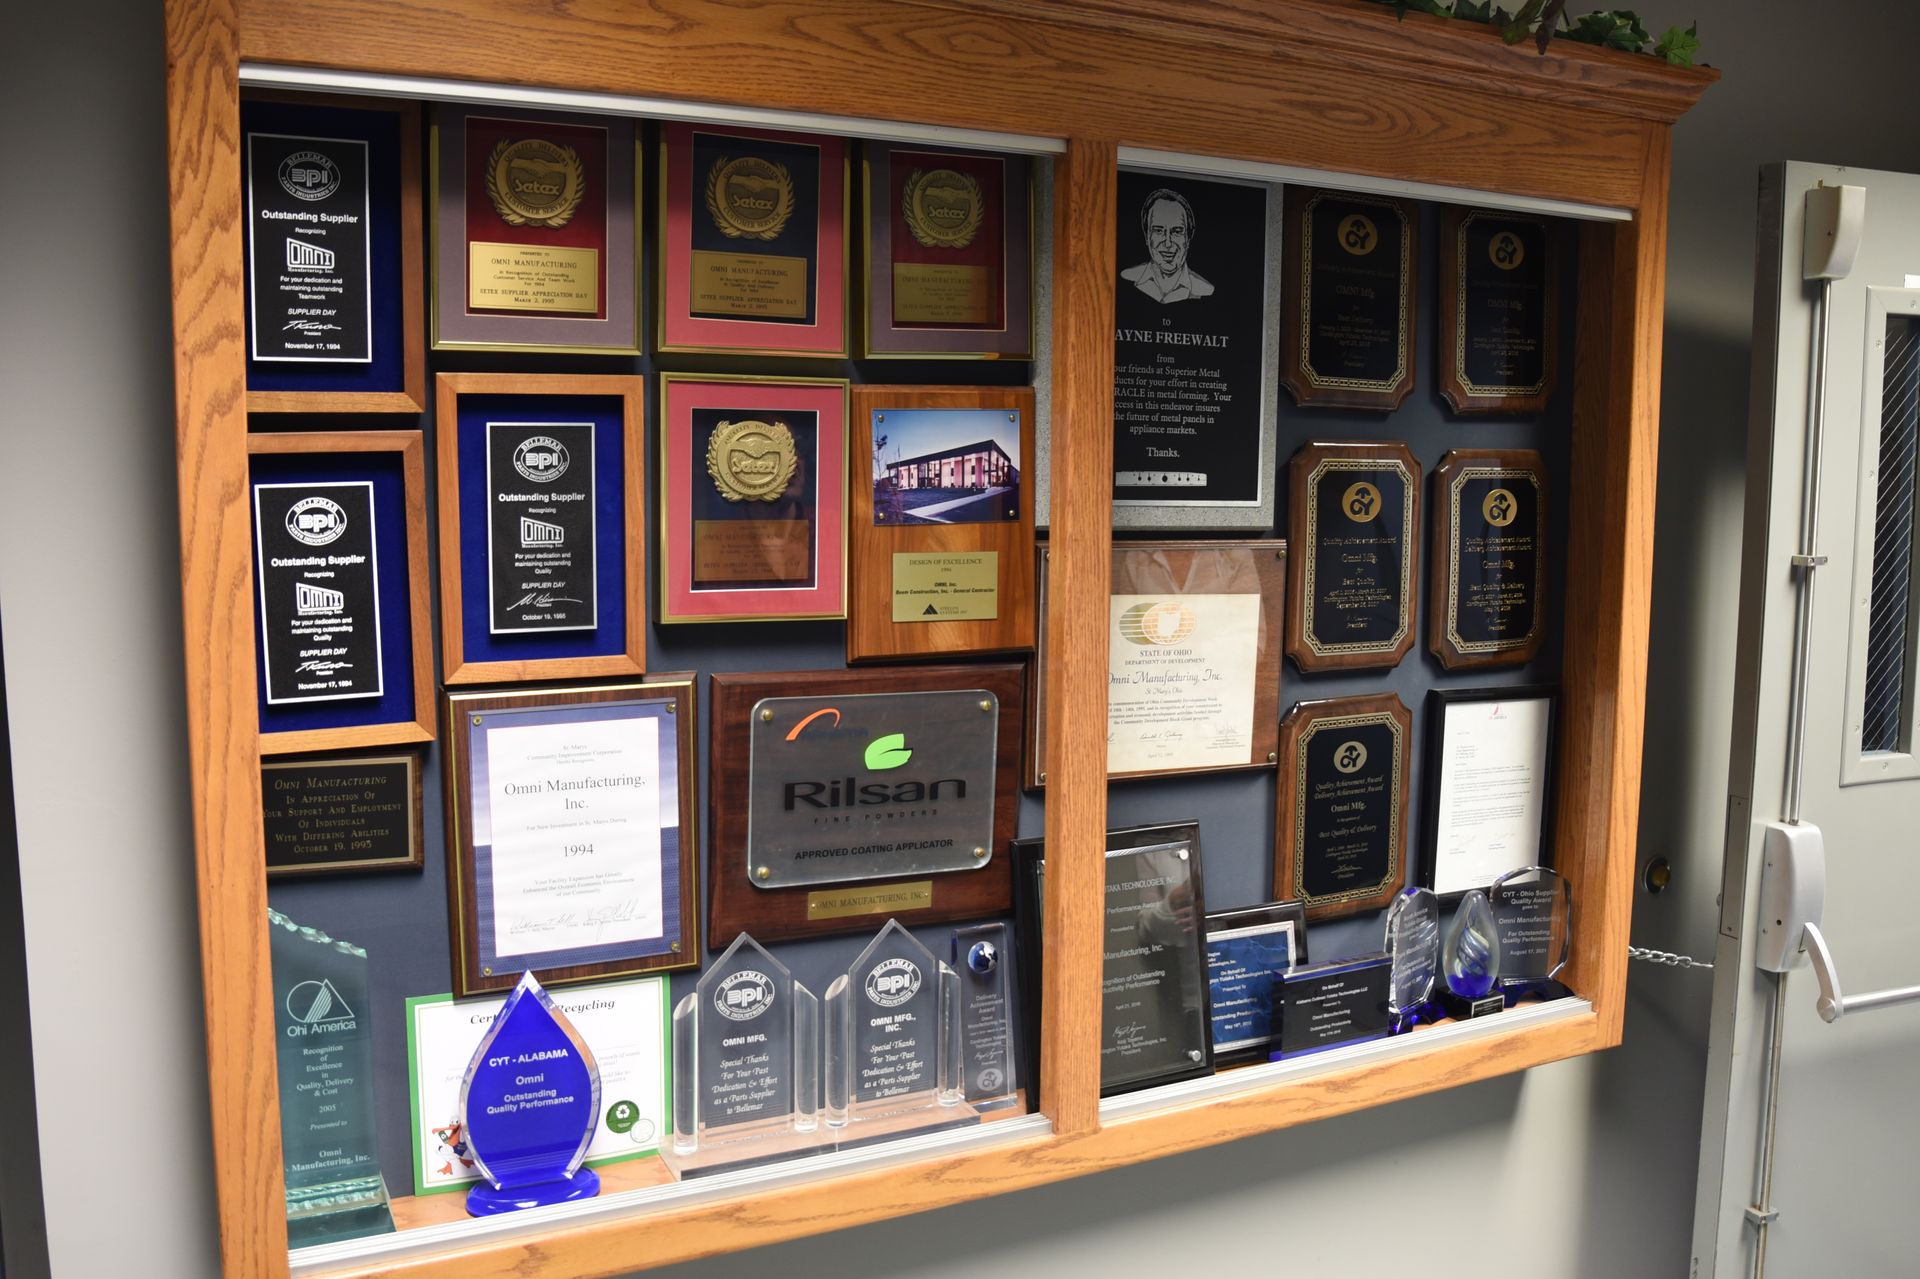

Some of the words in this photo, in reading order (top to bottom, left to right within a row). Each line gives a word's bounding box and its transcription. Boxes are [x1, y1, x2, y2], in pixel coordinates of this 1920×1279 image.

[292, 168, 328, 187] BPI
[262, 210, 318, 223] Outstanding
[320, 213, 359, 224] Supplier
[492, 258, 510, 266] OMNI
[515, 259, 577, 269] MANUFACTURING
[288, 308, 321, 316] SUPPLIER
[1162, 318, 1172, 326] to
[1114, 328, 1153, 343] AYNE
[1155, 331, 1229, 348] FREEWALT
[285, 342, 315, 350] November
[1156, 354, 1175, 364] from
[1128, 364, 1155, 375] friends
[1165, 366, 1198, 378] Superior
[1199, 368, 1221, 378] Metal
[1136, 375, 1147, 385] for
[1148, 378, 1167, 388] your
[1167, 377, 1190, 387] effort
[1198, 379, 1229, 392] creating
[1113, 387, 1147, 398] RACLE
[1157, 389, 1177, 399] metal
[1213, 392, 1233, 402] Your
[1145, 400, 1160, 410] this
[1160, 401, 1195, 412] endeavor
[1195, 402, 1222, 413] insures
[1126, 411, 1151, 422] future
[1161, 412, 1182, 423] metal
[1182, 414, 1206, 426] panels
[1129, 425, 1166, 436] appliance
[525, 453, 559, 469] BPI
[499, 492, 550, 503] Outstanding
[551, 493, 586, 503] Supplier
[299, 514, 335, 532] BPI
[271, 556, 326, 567] Outstanding
[327, 555, 366, 566] Supplier
[521, 582, 553, 590] SUPPLIER
[300, 649, 333, 657] SUPPLIER
[1139, 649, 1160, 657] STATE
[1162, 649, 1173, 657] OF
[1173, 648, 1193, 657] OHIO
[1168, 657, 1205, 665] DEVELOPMENT
[274, 778, 301, 791] OMNI
[306, 776, 388, 790] MANUFACTURING
[504, 779, 543, 798] Omni
[302, 793, 361, 804] APPRECIATION
[784, 777, 967, 812] Rilsan
[287, 807, 324, 817] SUPPORT
[351, 802, 402, 813] EMPLOYMENT
[564, 797, 590, 811] Inc.
[1330, 802, 1350, 813] Omni
[315, 817, 366, 828] INDIVIDUALS
[813, 815, 851, 826] FINE
[864, 807, 940, 822] POWDERS
[303, 831, 346, 841] DIFFERING
[351, 828, 390, 838] ABILITIES
[561, 843, 596, 858] 1994
[795, 845, 849, 862] APPROVED
[851, 842, 893, 857] COATING
[895, 838, 954, 853] APPLICATOR
[1498, 917, 1516, 925] Omni
[1502, 937, 1521, 945] Quality
[876, 973, 909, 994] BPI
[726, 987, 764, 1008] BPI
[287, 1022, 308, 1037] Ohi
[310, 1019, 356, 1035] America
[870, 1015, 893, 1028] OMNI
[885, 1024, 903, 1034] INC.
[722, 1036, 747, 1048] OMNI
[870, 1044, 893, 1056] Special
[893, 1039, 916, 1052] Thanks
[303, 1044, 344, 1056] Recognition
[884, 1052, 899, 1063] Your
[899, 1050, 915, 1061] Past
[489, 1056, 511, 1068] CYT
[517, 1048, 568, 1064] ALABAMA
[720, 1058, 744, 1070] Special
[744, 1052, 770, 1066] Thanks
[307, 1060, 344, 1072] Excellence
[862, 1066, 895, 1079] Dedication
[325, 1075, 355, 1089] Delivery
[515, 1073, 544, 1087] Omni
[323, 1088, 339, 1098] Cost
[503, 1088, 557, 1103] Outstanding
[487, 1102, 518, 1115] Quality
[519, 1095, 575, 1111] Performance
[310, 1121, 338, 1133] Presented
[320, 1147, 342, 1158] Omni
[292, 1154, 354, 1172] Manufacturing,
[356, 1152, 371, 1163] Inc.
